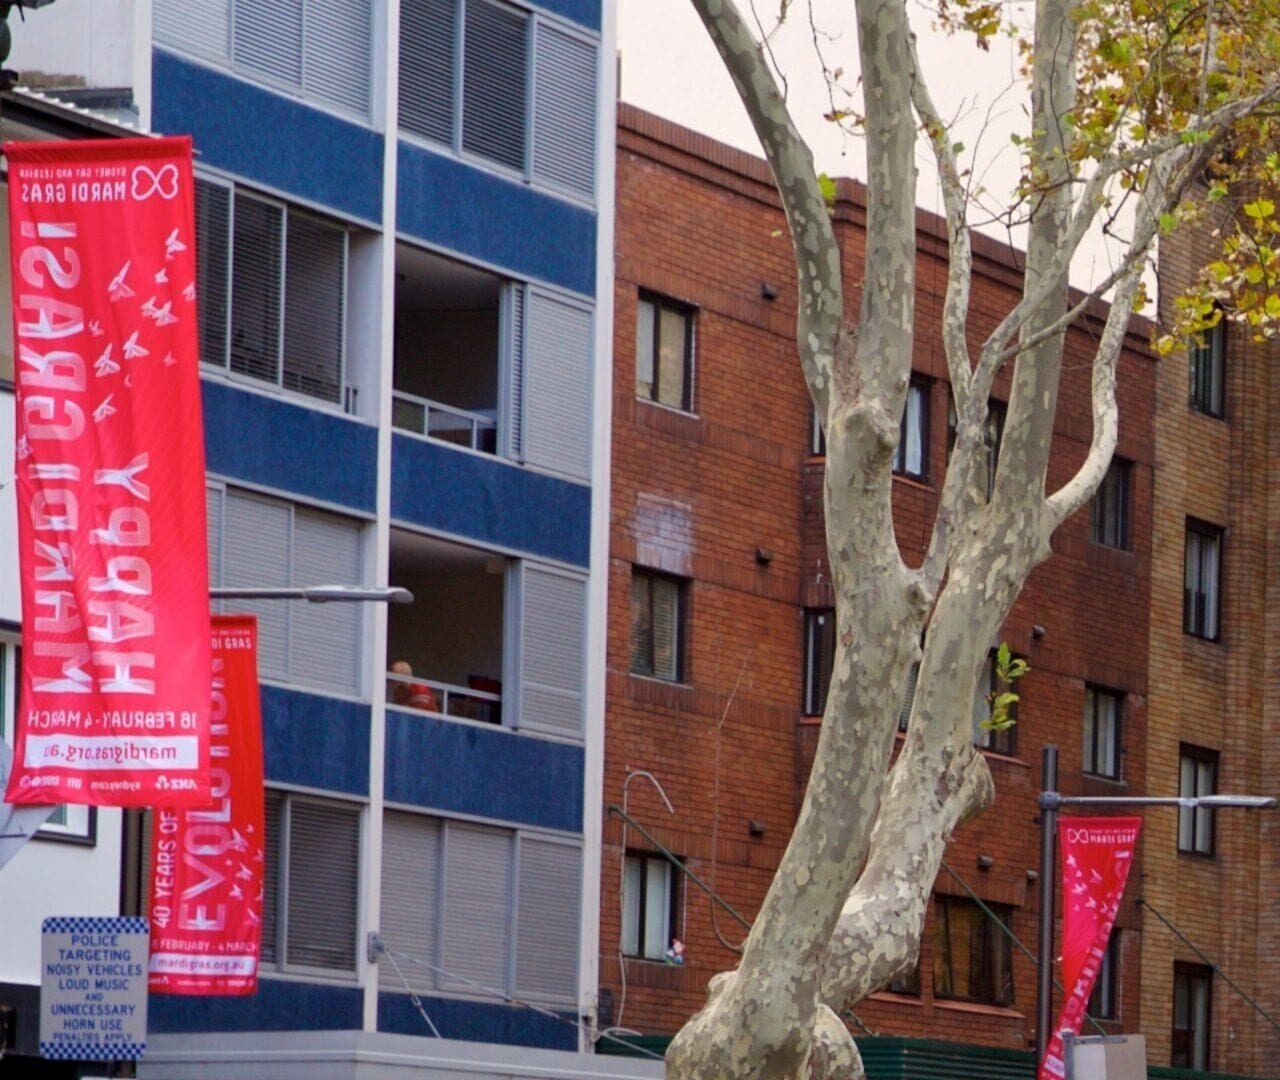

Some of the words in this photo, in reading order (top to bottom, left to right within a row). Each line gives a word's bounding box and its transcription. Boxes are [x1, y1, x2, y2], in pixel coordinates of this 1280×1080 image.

[225, 637, 252, 650] GRAS
[159, 810, 178, 834] OF
[155, 840, 177, 899] YEARS
[152, 905, 172, 929] 40
[71, 935, 119, 947] POLICE
[160, 938, 210, 951] FEBRUARY
[58, 949, 131, 961] TARGETING
[46, 964, 81, 976] NOISY
[87, 964, 142, 976] VEHICLES
[58, 979, 90, 990] LOUD
[95, 979, 130, 990] MUSIC
[85, 993, 103, 1001] AND
[51, 1004, 136, 1016] UNNECESSARY
[63, 1019, 96, 1030] HORN
[101, 1019, 123, 1030] USE
[53, 1032, 99, 1041] PENALTIES
[104, 1032, 133, 1041] APPLY
